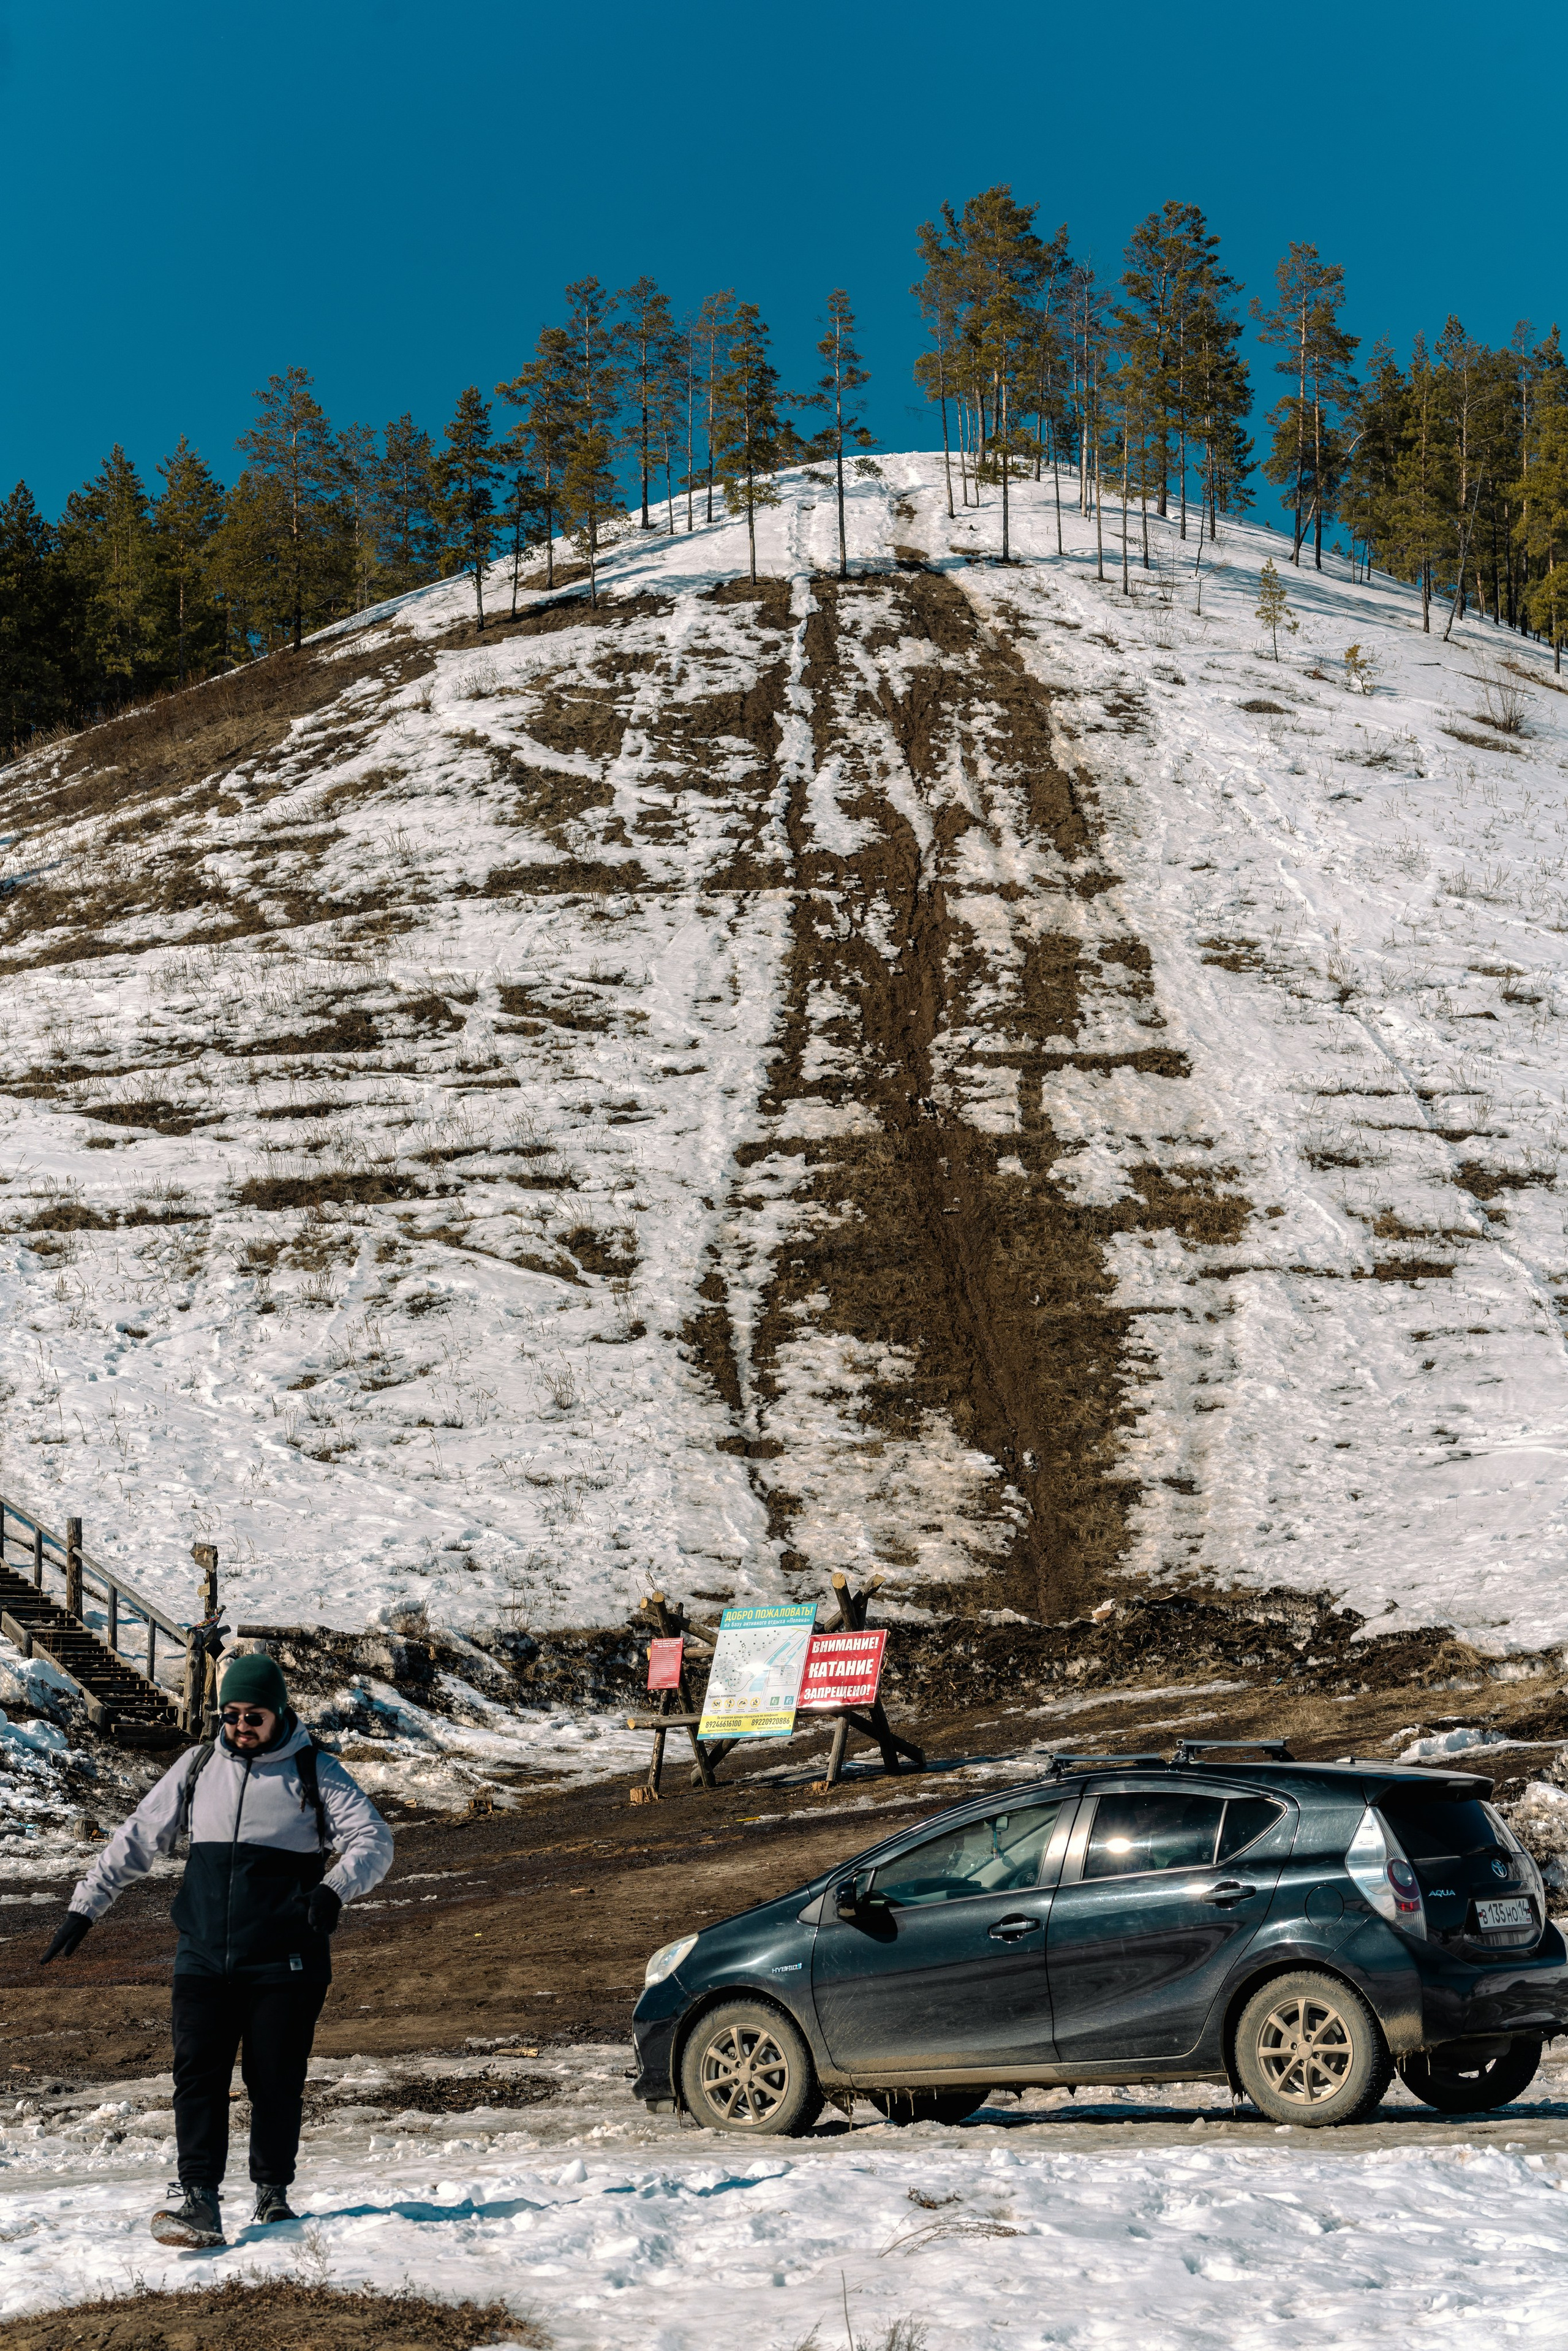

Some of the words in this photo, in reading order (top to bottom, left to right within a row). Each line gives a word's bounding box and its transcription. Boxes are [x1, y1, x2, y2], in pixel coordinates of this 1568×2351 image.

[725, 1610, 753, 1623] ДОБРО
[755, 1606, 813, 1619] ПОЖАЛОВАТЬ!
[812, 1637, 880, 1653] ВНИМАНИЕ!
[808, 1659, 874, 1678] КАТАНИЕ
[804, 1685, 871, 1700] ЗАПРЕЩЕНО!
[751, 1717, 790, 1726] 89220920886
[772, 1964, 797, 1974] HYBRID
